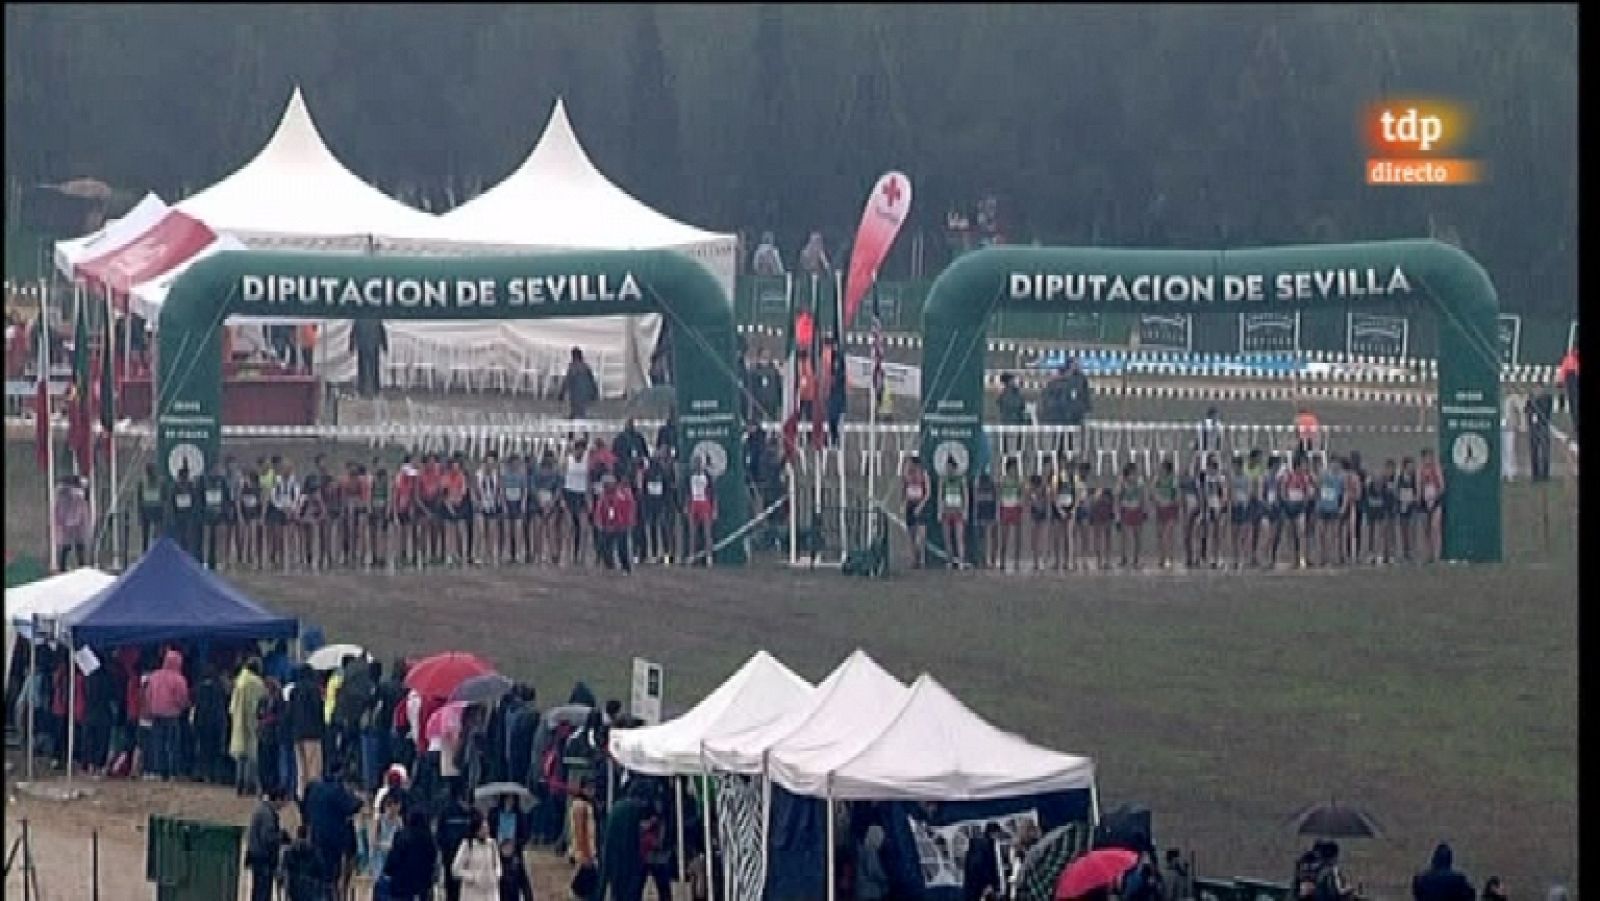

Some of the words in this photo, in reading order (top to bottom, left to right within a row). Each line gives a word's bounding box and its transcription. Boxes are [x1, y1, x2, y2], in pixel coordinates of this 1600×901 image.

[242, 274, 448, 307] DIPUTACION
[456, 278, 498, 307] DE
[506, 269, 644, 306] SEVILLA
[1009, 272, 1216, 302] DIPUTACION
[1223, 273, 1265, 301] DE
[1275, 264, 1413, 300] SEVILLA
